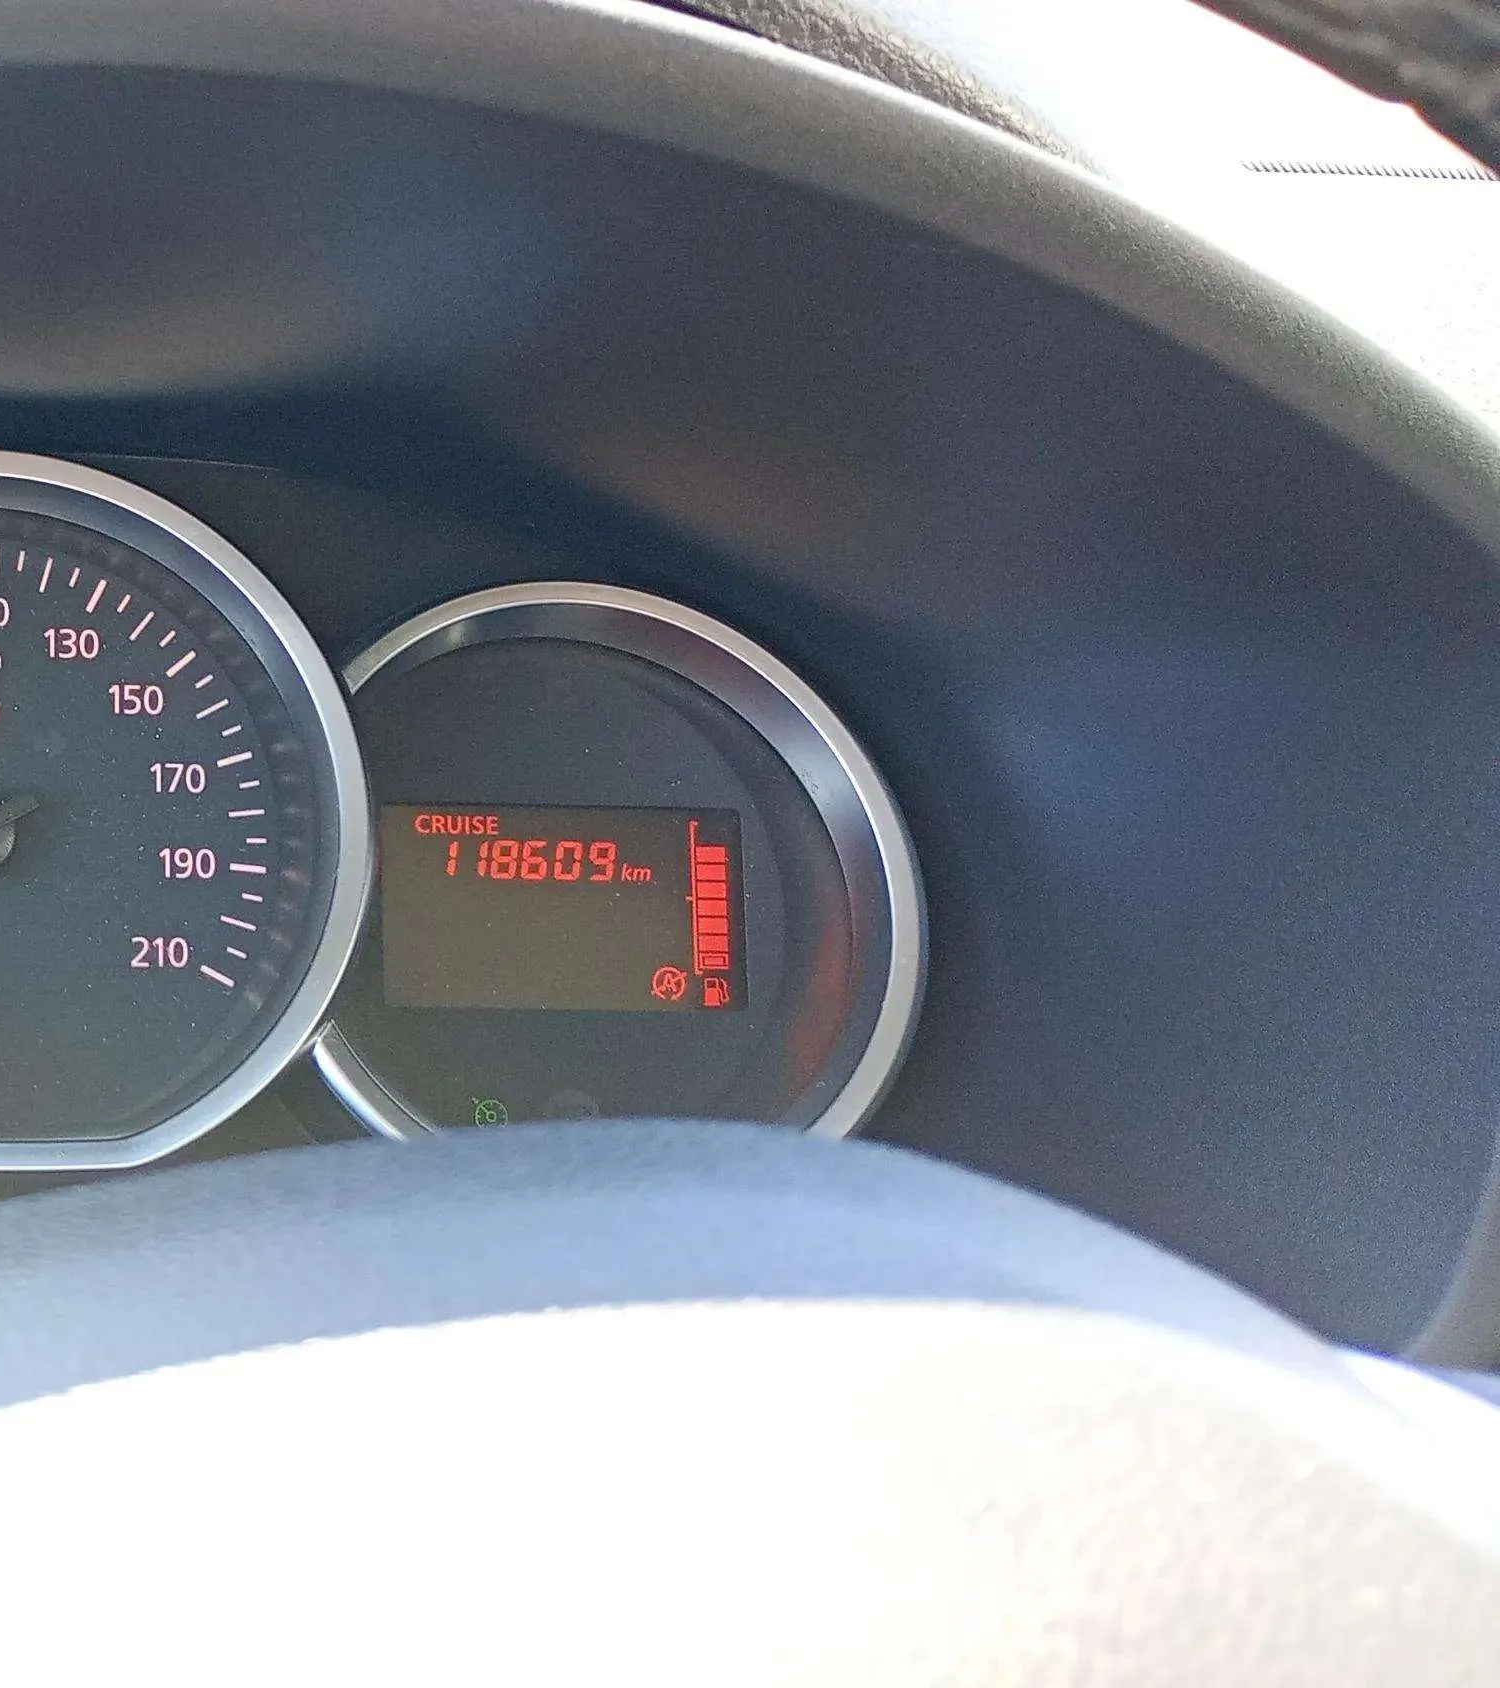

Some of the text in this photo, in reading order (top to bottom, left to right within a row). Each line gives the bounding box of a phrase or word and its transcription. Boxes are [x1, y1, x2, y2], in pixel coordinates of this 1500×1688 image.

[44, 629, 98, 658] 130
[109, 685, 163, 714] 150
[151, 764, 205, 793] 170
[414, 814, 499, 835] CRUISE
[159, 848, 215, 878] 190
[446, 840, 652, 881] 118609 km
[131, 937, 188, 967] 210
